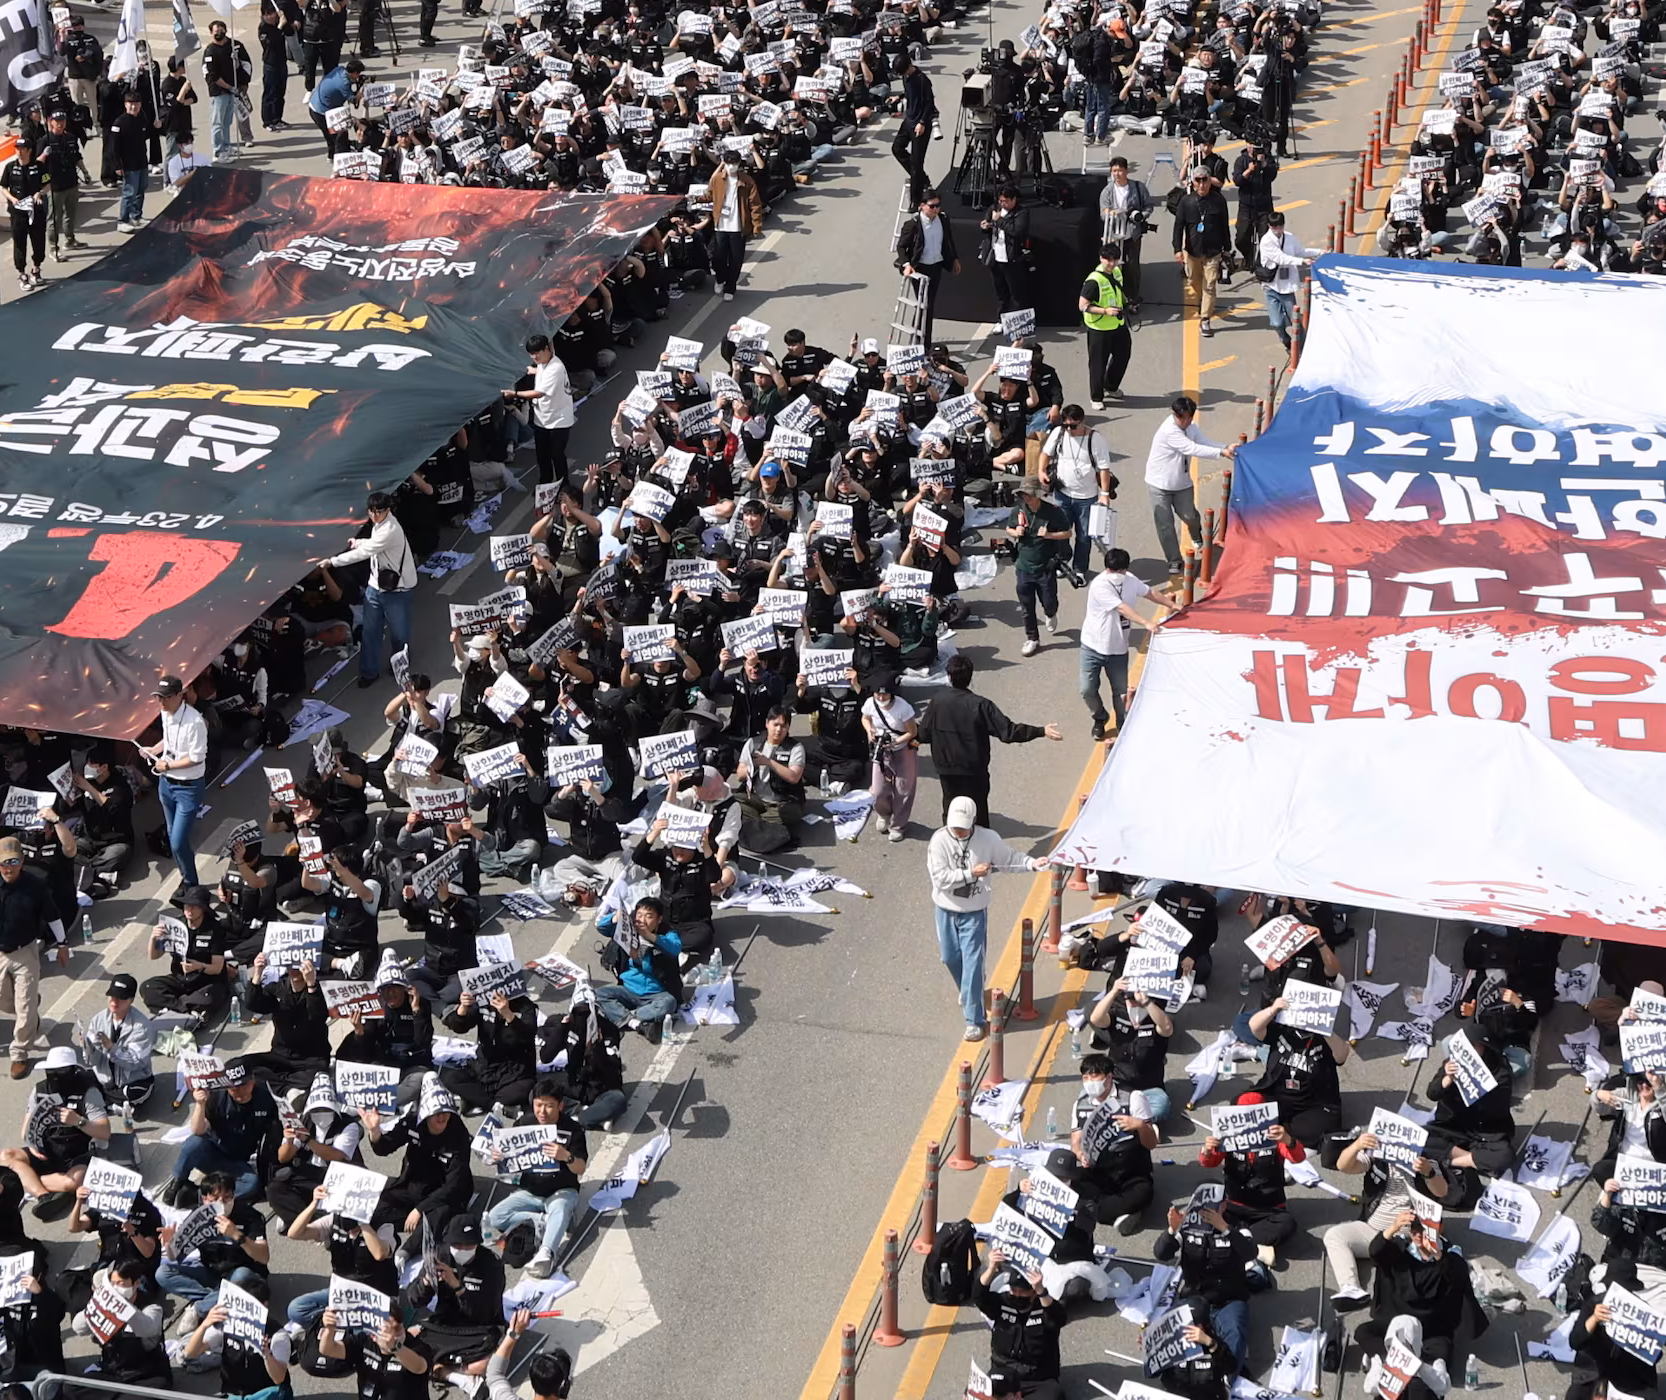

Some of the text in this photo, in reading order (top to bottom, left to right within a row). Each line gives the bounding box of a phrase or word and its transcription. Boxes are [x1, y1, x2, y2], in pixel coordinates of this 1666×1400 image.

[51, 313, 433, 374] 상한폐지
[775, 432, 811, 447] 상한폐지
[635, 489, 672, 504] 상한폐지
[889, 571, 929, 586] 상한폐지
[765, 594, 804, 610] 상한폐지
[889, 583, 930, 603] 실현하자
[627, 629, 670, 646] 상한폐지
[724, 619, 768, 639] 상한폐지
[803, 654, 847, 671] 상한폐지
[552, 748, 596, 763] 상한폐지
[644, 735, 690, 757] 상한폐지
[469, 749, 514, 771] 상한폐지
[479, 762, 521, 785] 실현하자
[425, 792, 459, 805] 투명하게
[663, 807, 705, 826] 상한폐지
[269, 928, 315, 942] 상한폐지
[269, 949, 320, 965] 실현하자
[1130, 954, 1173, 974] 상한폐지
[465, 962, 516, 991] 상한폐지
[326, 985, 372, 999] 투명하게
[1285, 989, 1332, 1010] 상한폐지
[337, 1001, 382, 1018] 바꾸고!!!
[1286, 1008, 1335, 1028] 실현하자
[339, 1068, 392, 1091] 상한폐지
[344, 1090, 396, 1112] 실현하자
[1217, 1107, 1272, 1133] 상한폐지
[1375, 1118, 1422, 1144] 상한폐지
[499, 1129, 549, 1153] 상한폐지
[505, 1149, 559, 1173] 실현하자
[1373, 1140, 1417, 1165] 실현하자
[90, 1167, 138, 1193] 상한폐지
[1029, 1177, 1073, 1205] 상한폐지
[1026, 1198, 1068, 1226] 실현하자
[996, 1215, 1048, 1251] 상한폐지
[223, 1292, 263, 1319] 상한폐지
[332, 1287, 384, 1310] 상한폐지
[1609, 1294, 1665, 1332] 상한폐지
